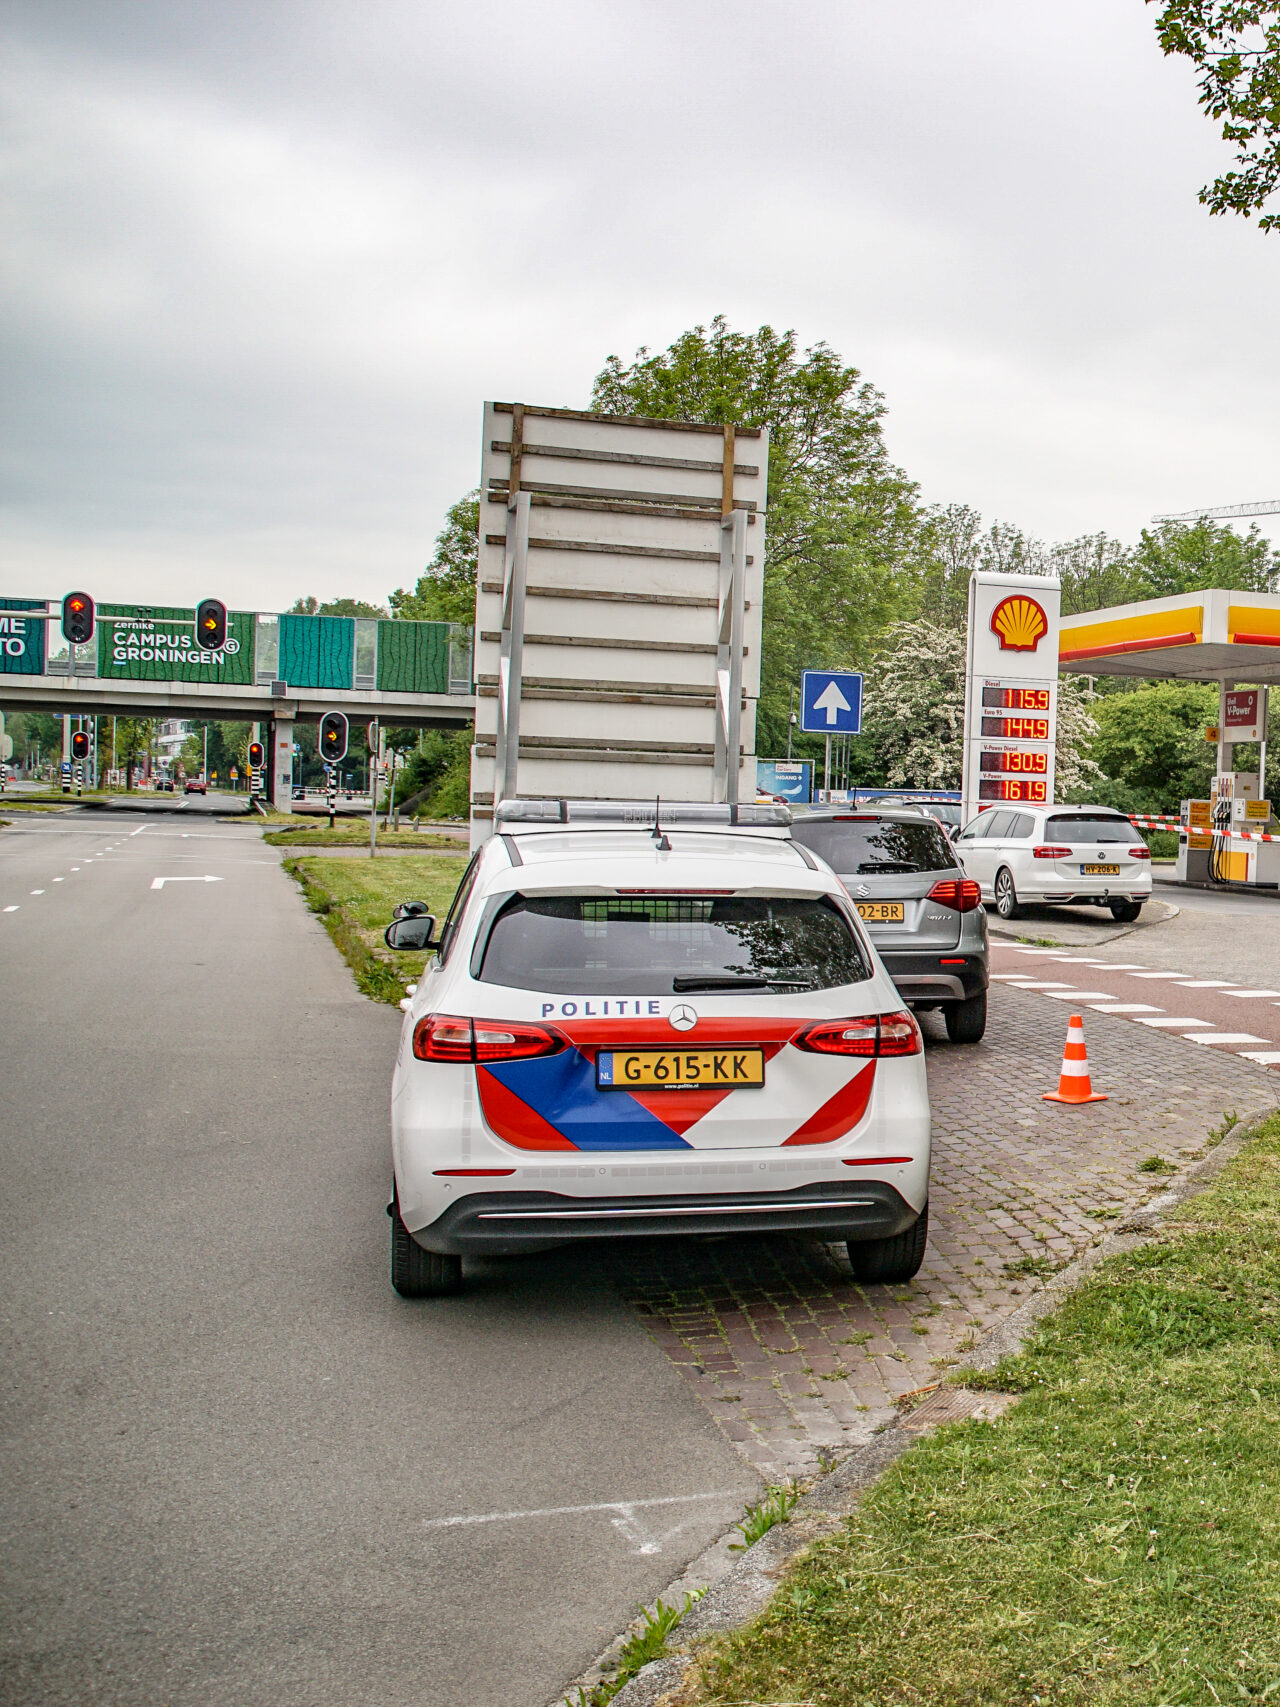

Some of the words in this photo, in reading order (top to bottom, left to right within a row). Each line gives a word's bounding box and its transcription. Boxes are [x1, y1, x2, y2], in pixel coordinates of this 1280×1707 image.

[112, 631, 192, 648] CAMPUS
[112, 647, 225, 665] GRONINGEN
[1008, 689, 1048, 709] 115.9
[1227, 705, 1251, 716] V-Power
[1007, 719, 1048, 738] 144.9
[1210, 730, 1217, 738] 4
[1005, 752, 1047, 771] 130.9
[1005, 780, 1045, 800] 161.9
[541, 1000, 661, 1018] POLITIE
[600, 1072, 612, 1080] NL
[624, 1055, 749, 1081] G-615-KK
